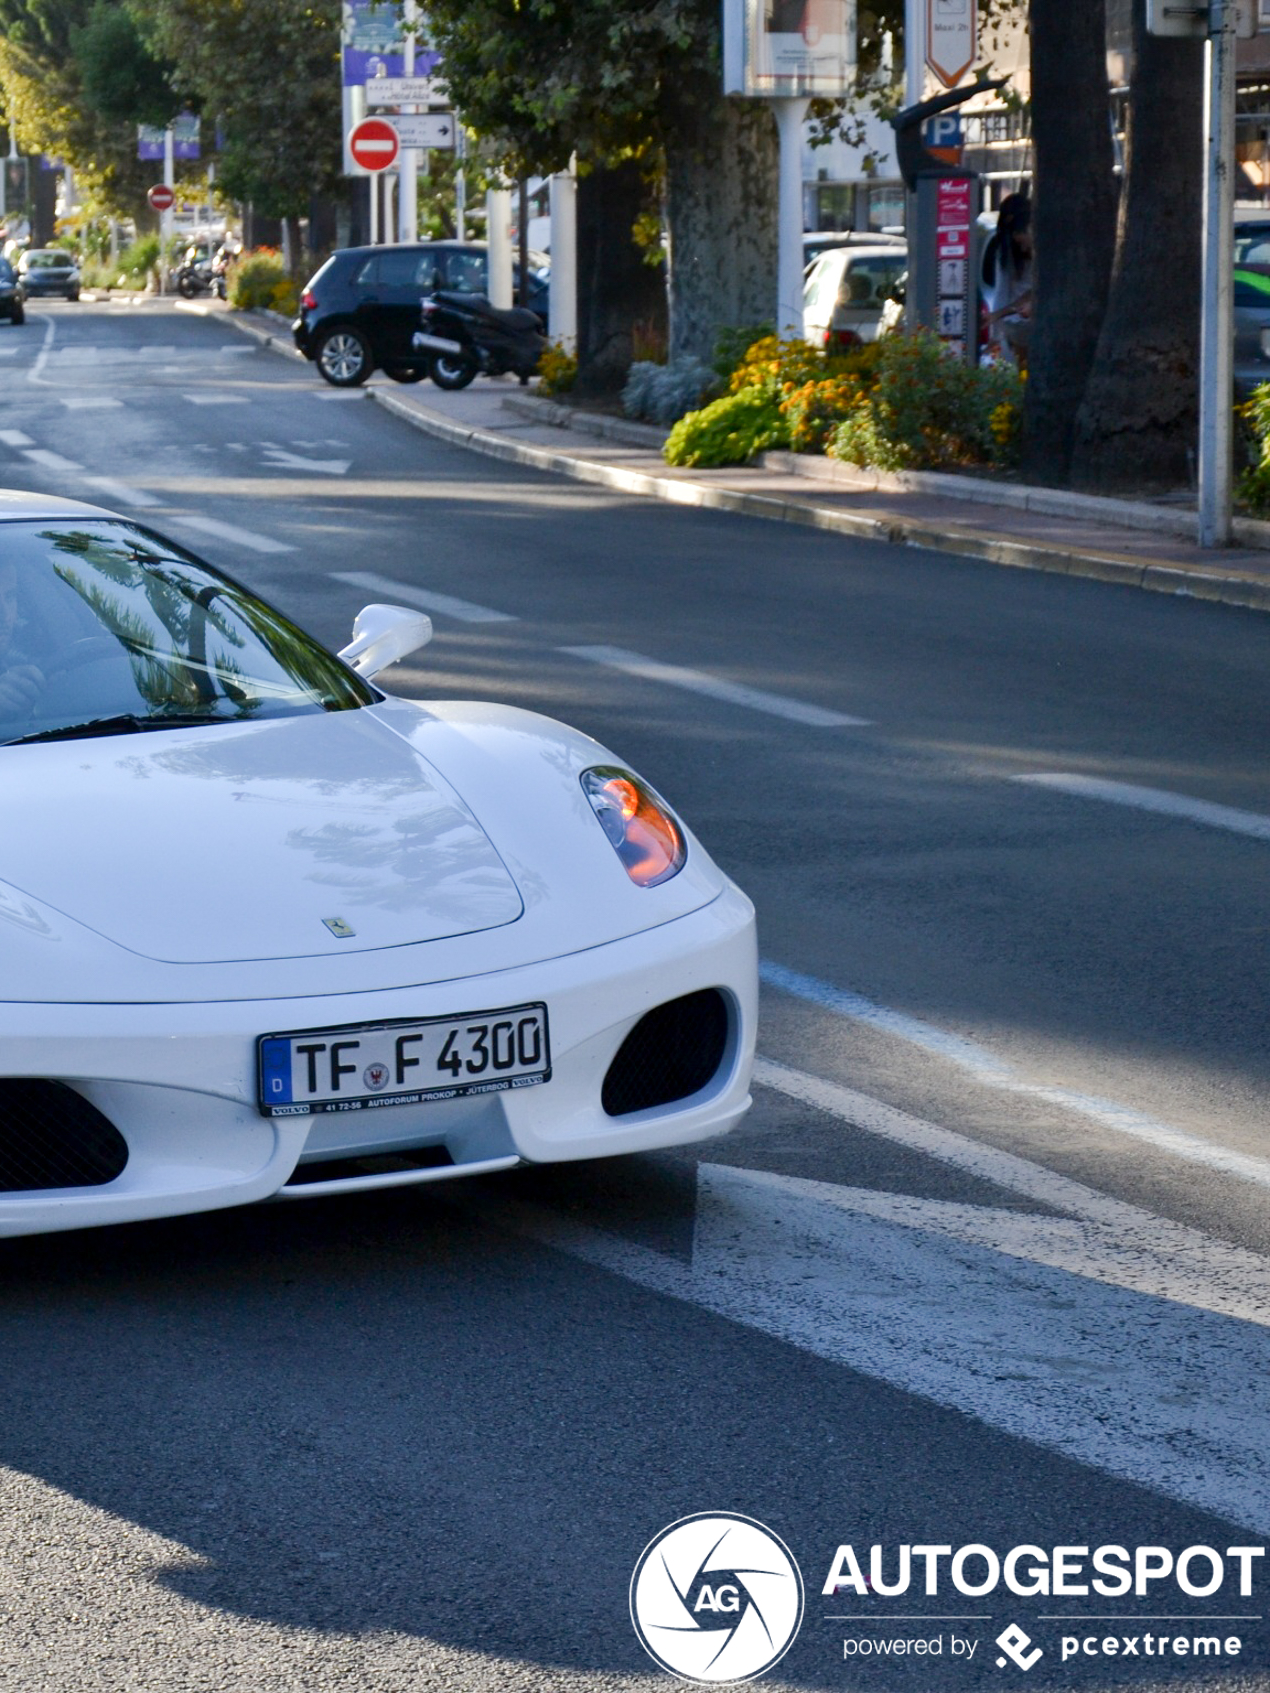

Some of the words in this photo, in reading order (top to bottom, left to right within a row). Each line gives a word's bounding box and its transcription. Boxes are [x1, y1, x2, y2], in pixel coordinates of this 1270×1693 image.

[934, 23, 956, 31] Maxi
[934, 120, 956, 145] P
[297, 1041, 360, 1092] TF
[395, 1034, 423, 1084] F
[437, 1016, 542, 1077] 4300
[271, 1078, 283, 1093] D
[273, 1106, 310, 1115] VOLVO
[367, 1094, 419, 1108] AUTOFORUM
[421, 1090, 457, 1102] PROKOP
[466, 1081, 509, 1096] JÜTERBOG
[513, 1076, 543, 1087] VOLVO
